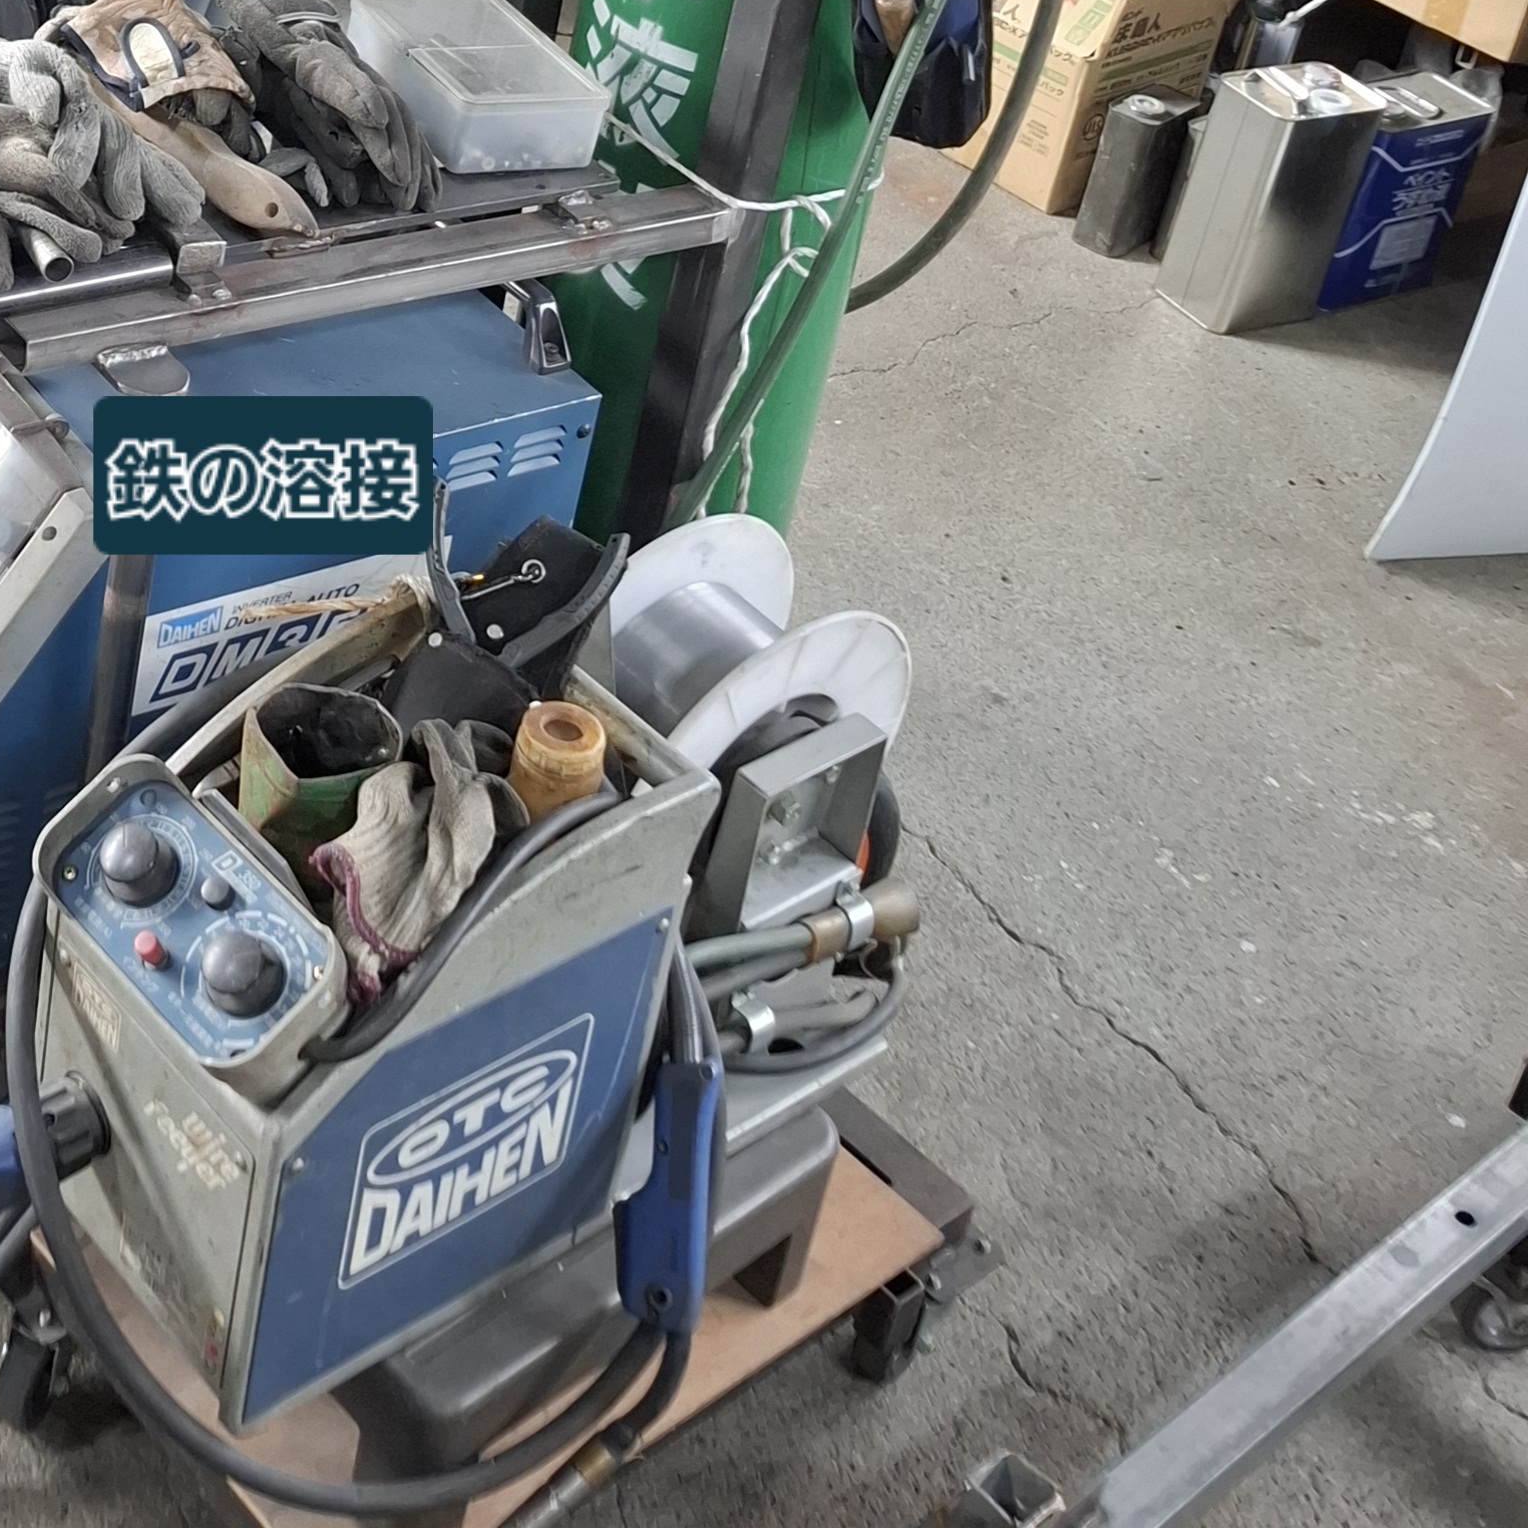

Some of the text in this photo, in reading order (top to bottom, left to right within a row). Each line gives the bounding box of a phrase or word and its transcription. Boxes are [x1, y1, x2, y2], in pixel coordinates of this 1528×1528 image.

[158, 607, 223, 648] DAIHEN
[398, 1064, 550, 1170] OTC
[350, 1075, 574, 1276] DAIHEN
